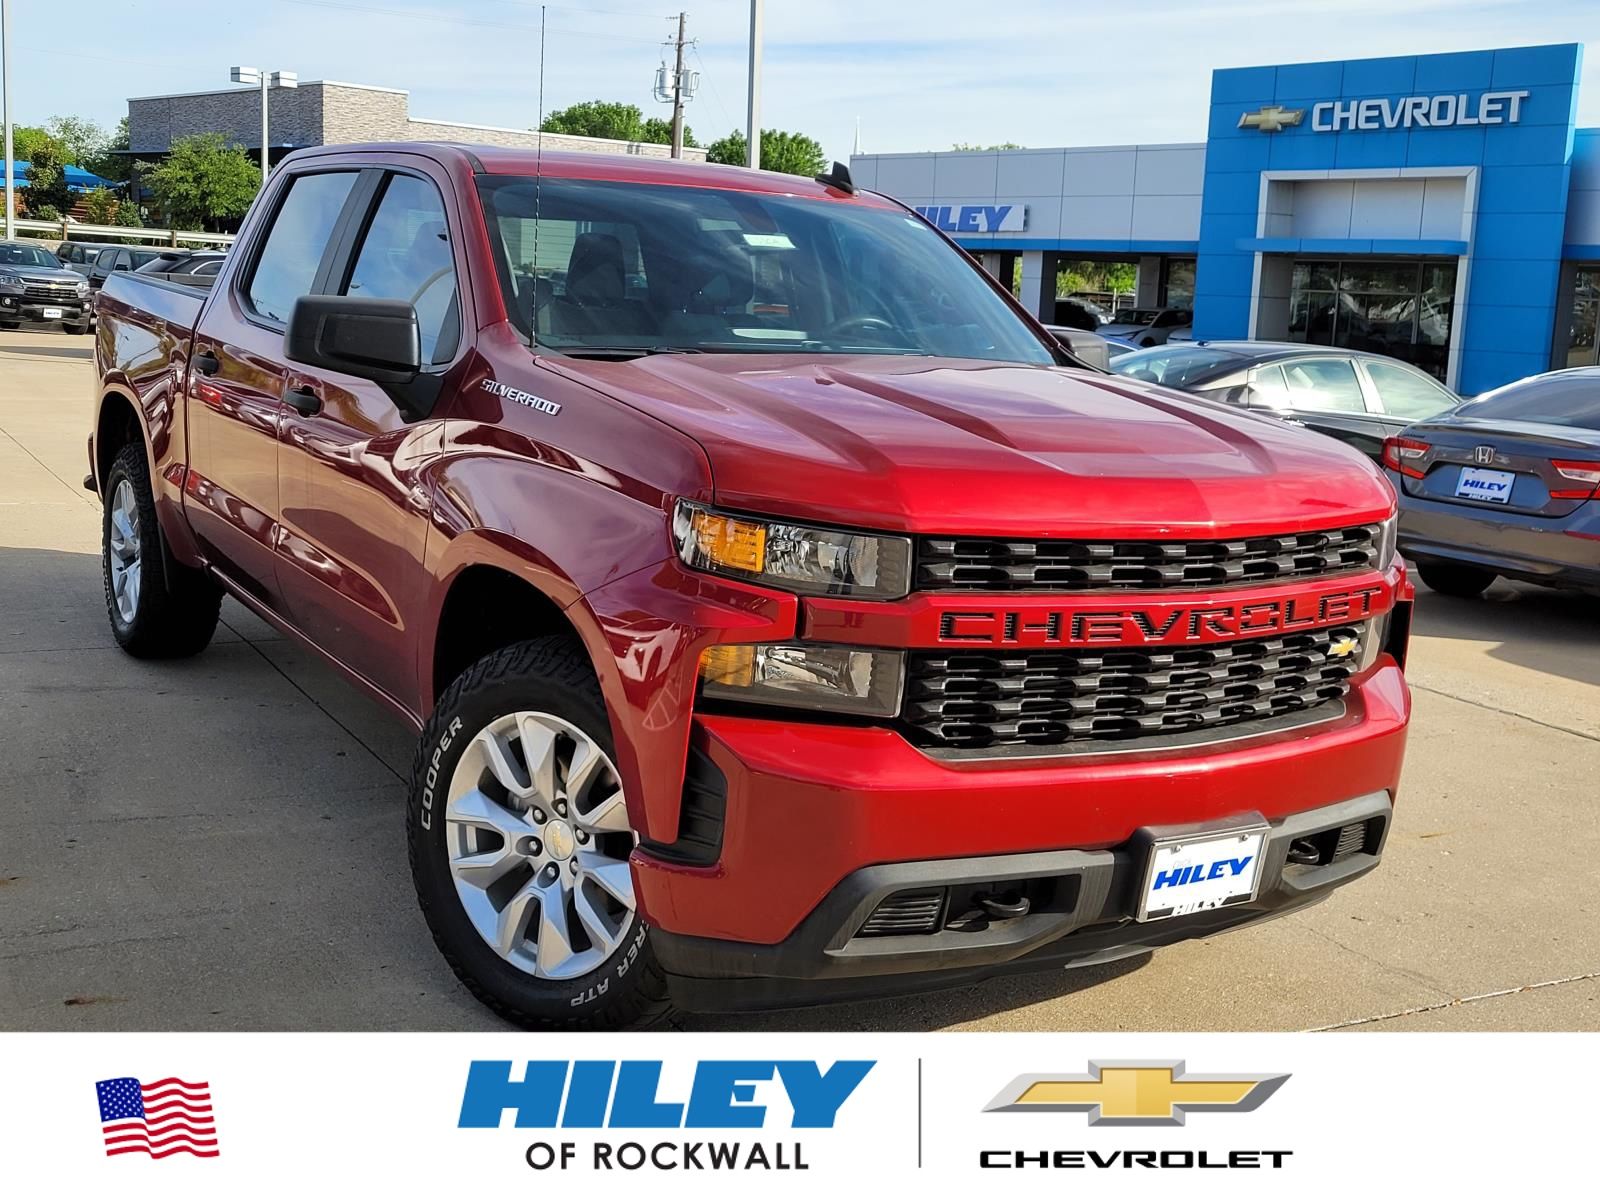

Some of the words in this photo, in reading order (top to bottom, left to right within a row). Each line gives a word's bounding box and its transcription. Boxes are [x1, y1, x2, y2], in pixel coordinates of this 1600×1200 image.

[1312, 91, 1529, 132] CHEVROLET
[914, 206, 1013, 232] ILEY
[480, 379, 562, 415] SILVERADO
[1463, 479, 1507, 491] HILEY
[938, 586, 1382, 644] CHEVROLET
[421, 716, 463, 831] COOPER
[1152, 855, 1254, 891] HILEY
[570, 978, 609, 1007] ATP
